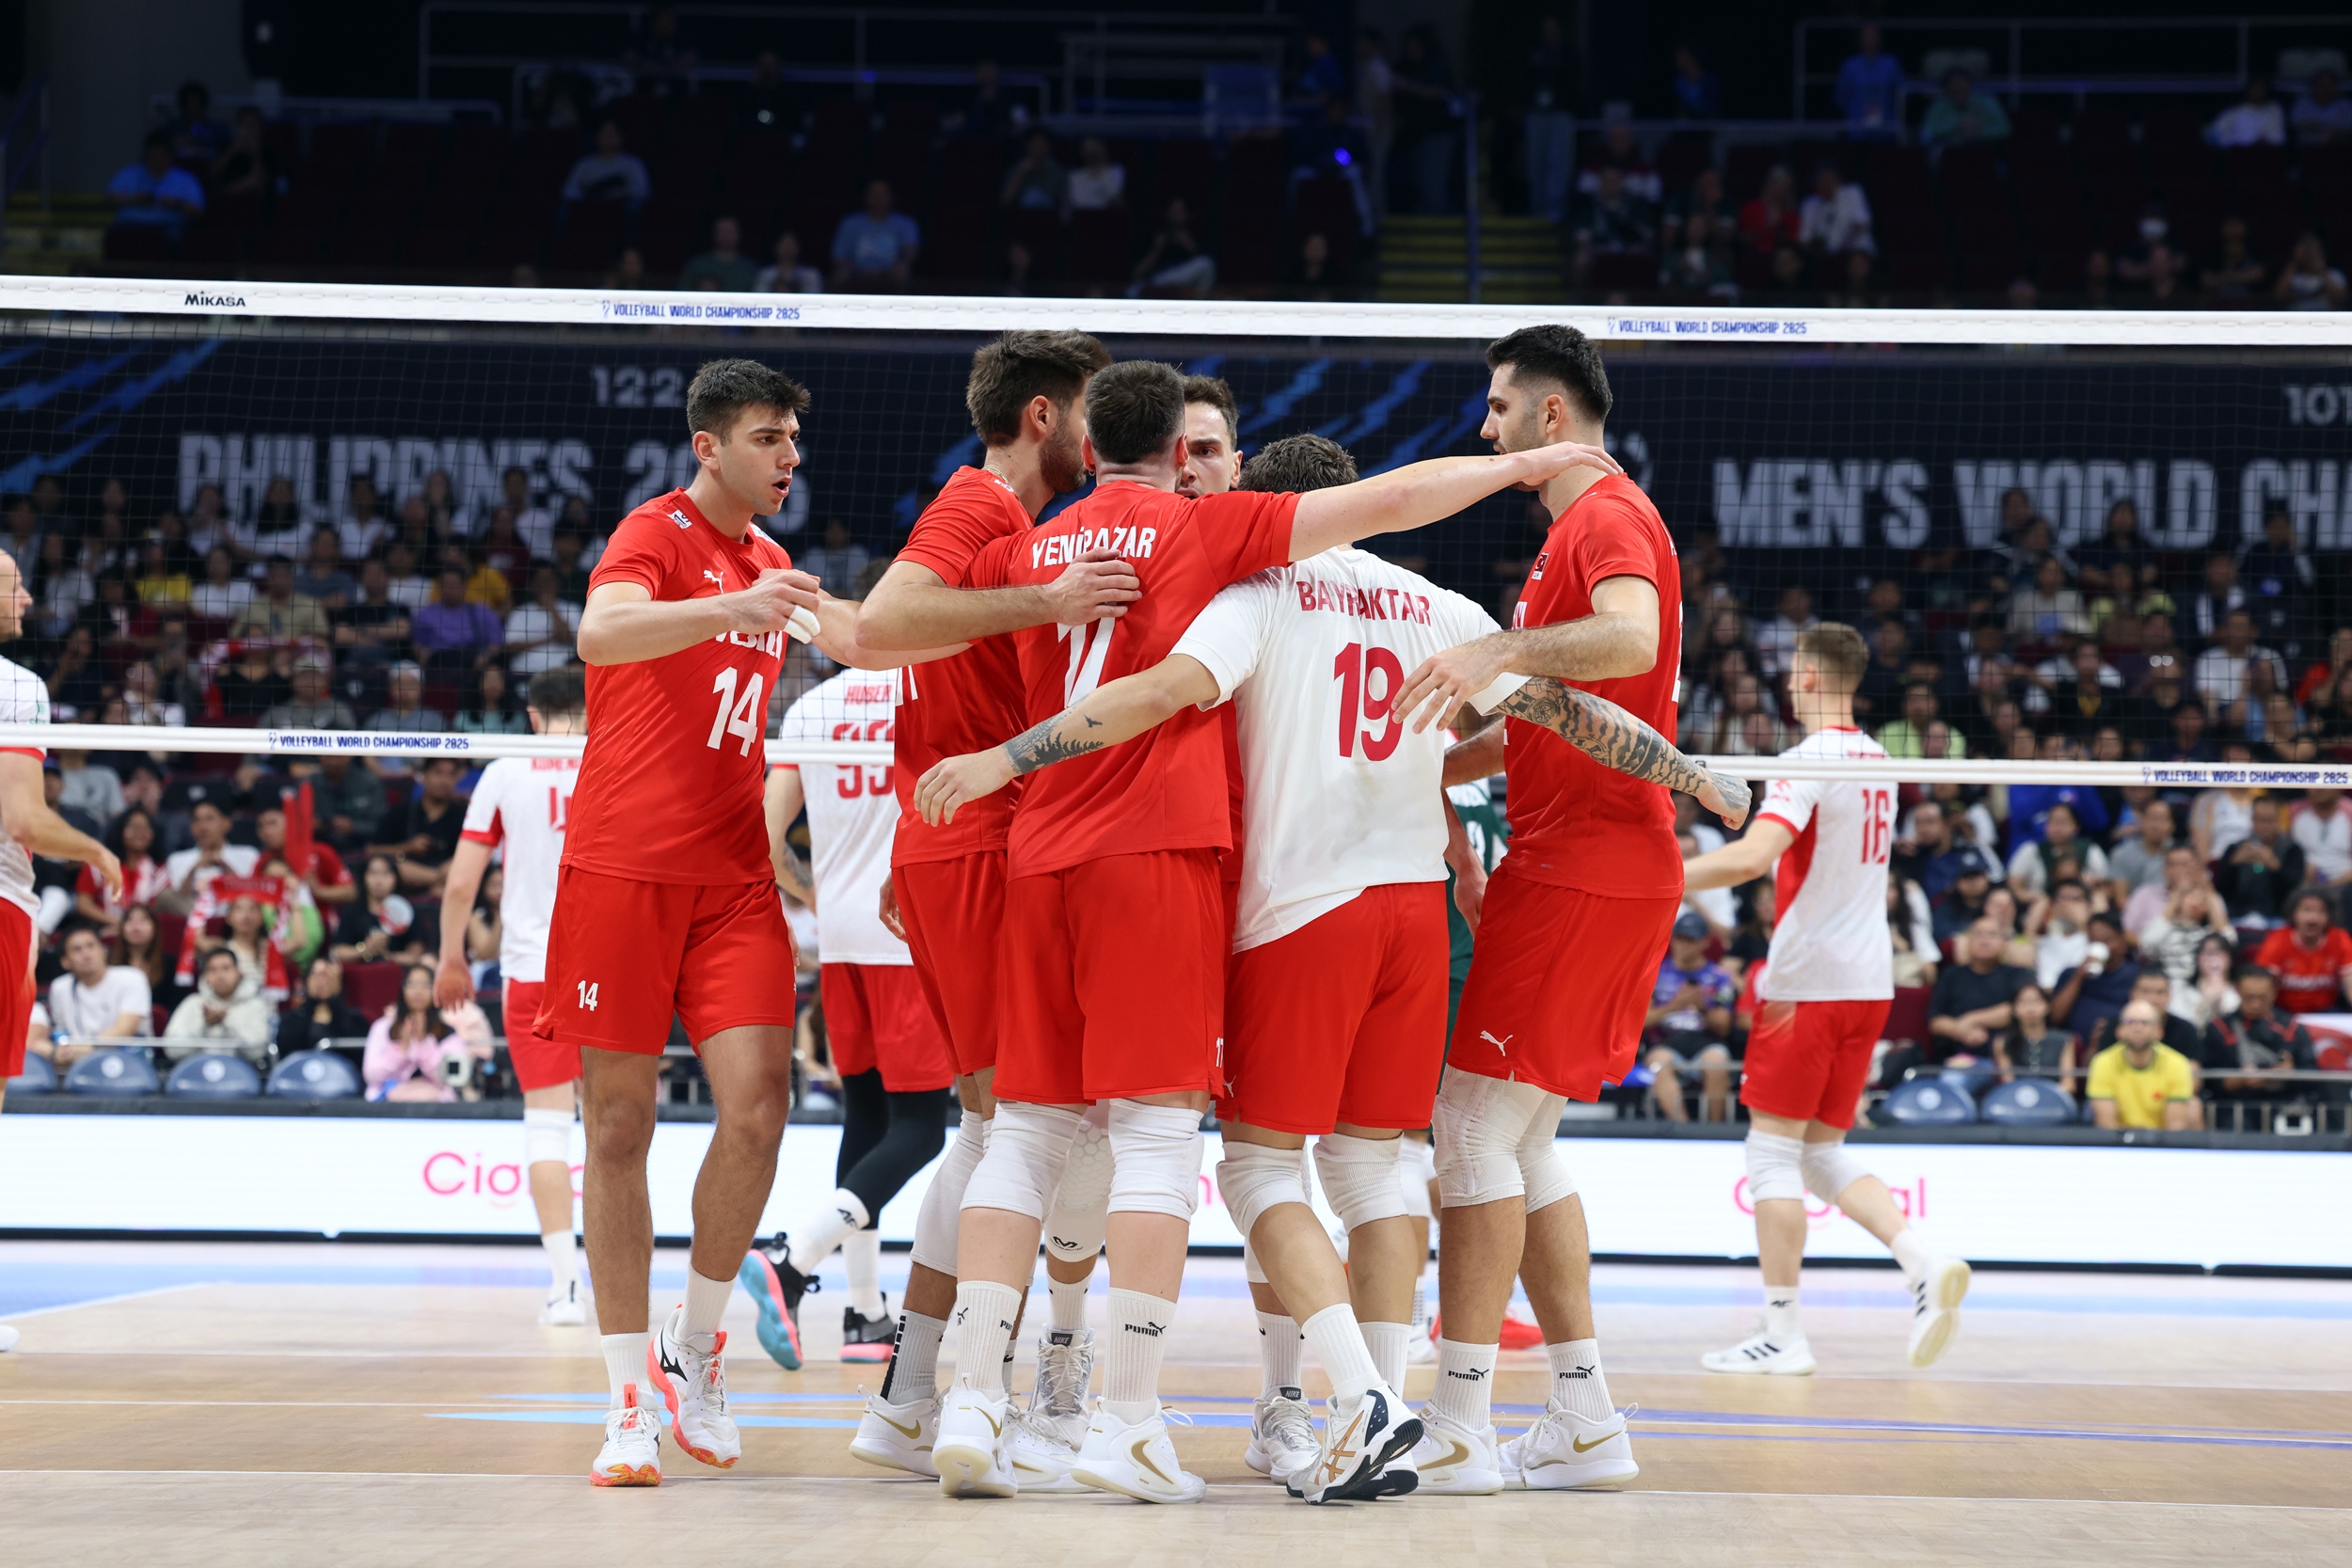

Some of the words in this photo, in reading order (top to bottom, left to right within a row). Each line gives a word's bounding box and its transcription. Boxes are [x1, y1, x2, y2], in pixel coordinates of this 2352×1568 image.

[613, 304, 665, 317] VOLLEYBALL
[669, 305, 702, 318] WORLD
[706, 306, 772, 320] CHAMPIONSHIP
[1619, 320, 1670, 332] VOLLEYBALL
[1676, 321, 1708, 333] WORLD
[1711, 322, 1779, 334] CHAMPIONSHIP
[177, 431, 596, 519] PHILIPPINES
[1714, 457, 1931, 549] MEN'S
[1295, 579, 1432, 627] BAYRAKTAR
[1334, 641, 1406, 762] 19
[707, 666, 764, 758] 14
[280, 736, 333, 748] VOLLEYBALL
[337, 736, 371, 748] WORLD
[373, 736, 441, 749] CHAMPIONSHIP
[2154, 769, 2207, 783] VOLLEYBALL
[2212, 770, 2247, 784] WORLD
[2249, 771, 2320, 784] CHAMPIONSHIP
[577, 979, 599, 1012] 14
[1125, 1323, 1158, 1338] PUMA
[1054, 1336, 1070, 1344] NIKE
[1448, 1370, 1480, 1382] PUMA
[1559, 1370, 1588, 1380] PUMA
[1285, 1389, 1300, 1399] NIKE
